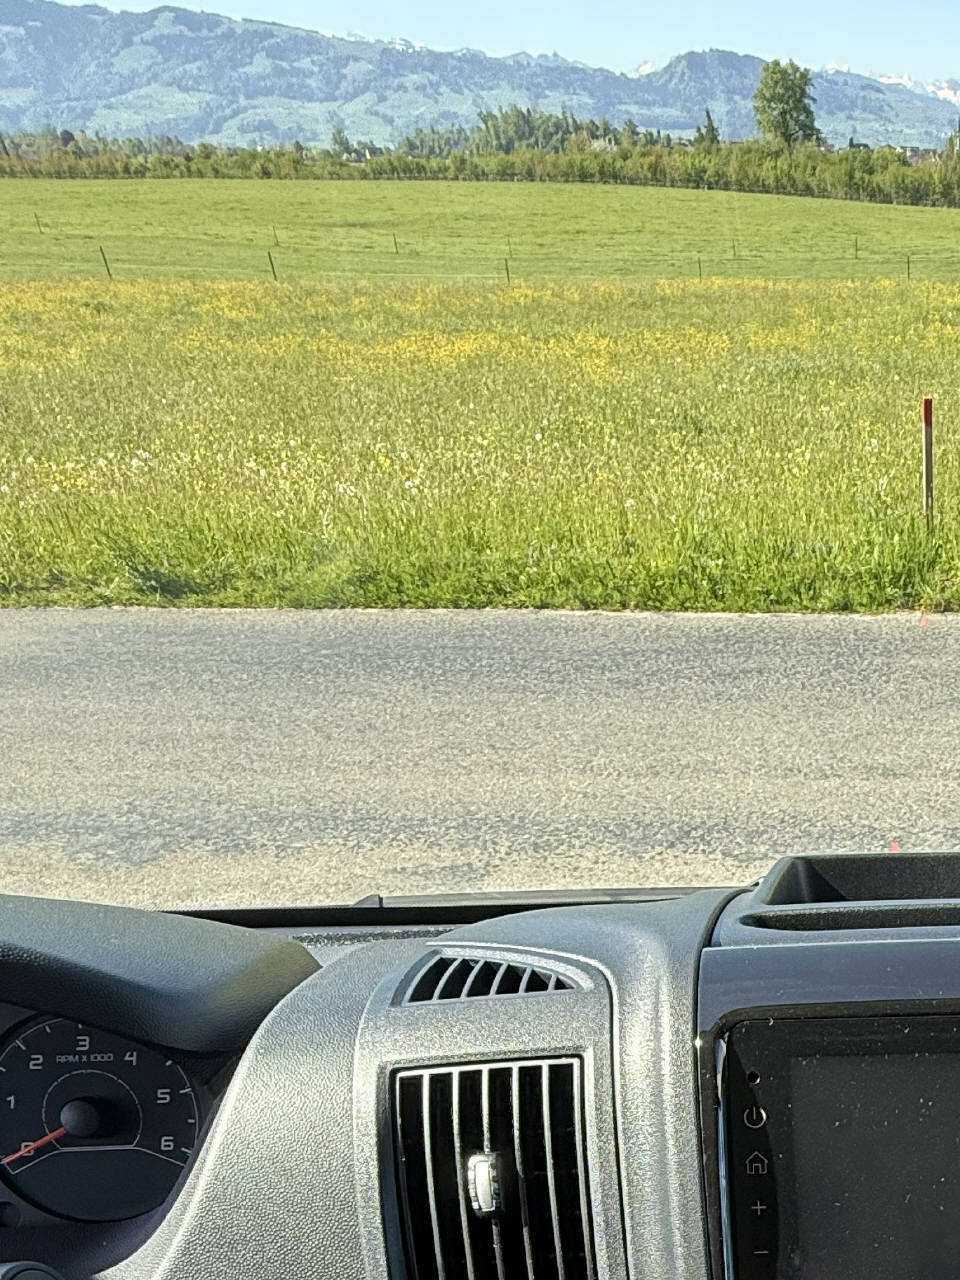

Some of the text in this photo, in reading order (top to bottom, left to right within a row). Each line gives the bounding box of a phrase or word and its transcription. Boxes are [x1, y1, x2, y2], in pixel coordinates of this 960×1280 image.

[76, 1036, 90, 1051] 3
[29, 1054, 43, 1069] 2
[56, 1055, 79, 1063] RPM
[90, 1053, 114, 1062] 1000
[124, 1051, 137, 1066] 4
[6, 1095, 15, 1109] 1
[156, 1089, 170, 1104] 5
[160, 1136, 174, 1151] 6
